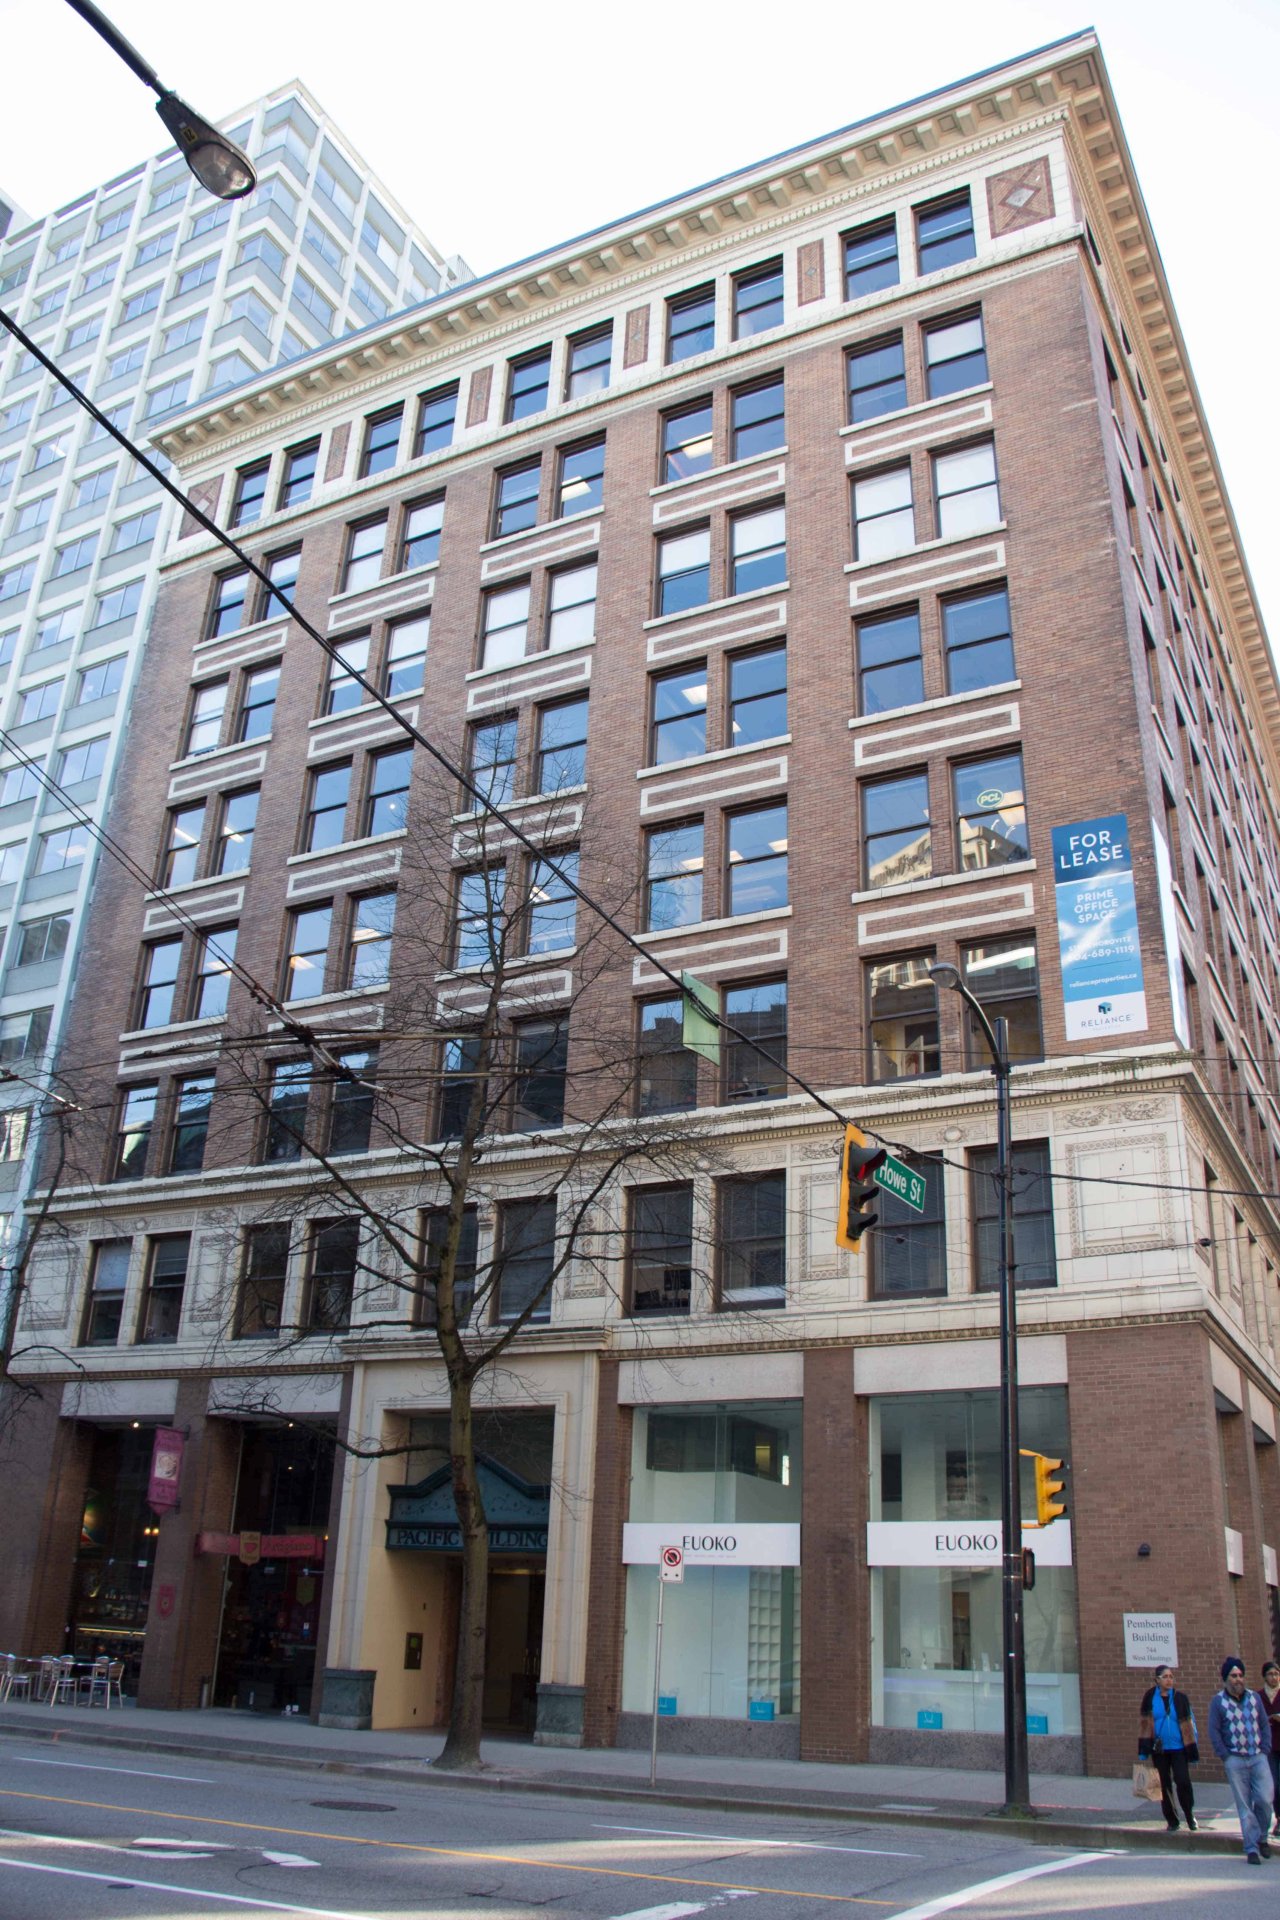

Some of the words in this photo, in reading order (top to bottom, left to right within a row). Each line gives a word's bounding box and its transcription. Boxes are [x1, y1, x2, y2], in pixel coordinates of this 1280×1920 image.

[980, 792, 1001, 805] PCL
[1069, 831, 1111, 851] FOR
[1060, 844, 1124, 869] LEASE
[1076, 888, 1115, 904] PRIME
[1074, 898, 1119, 914] OFFICE
[1078, 909, 1117, 924] SPACE
[1081, 1014, 1132, 1028] RELIANCE
[879, 1160, 907, 1194] Howe
[910, 1178, 921, 1203] St
[396, 1528, 460, 1546] PACIFIC
[489, 1530, 548, 1547] ILDING
[683, 1535, 737, 1551] EUOKO
[935, 1534, 998, 1551] EUOKO
[1127, 1619, 1173, 1629] Pemberton
[1132, 1632, 1170, 1645] Building
